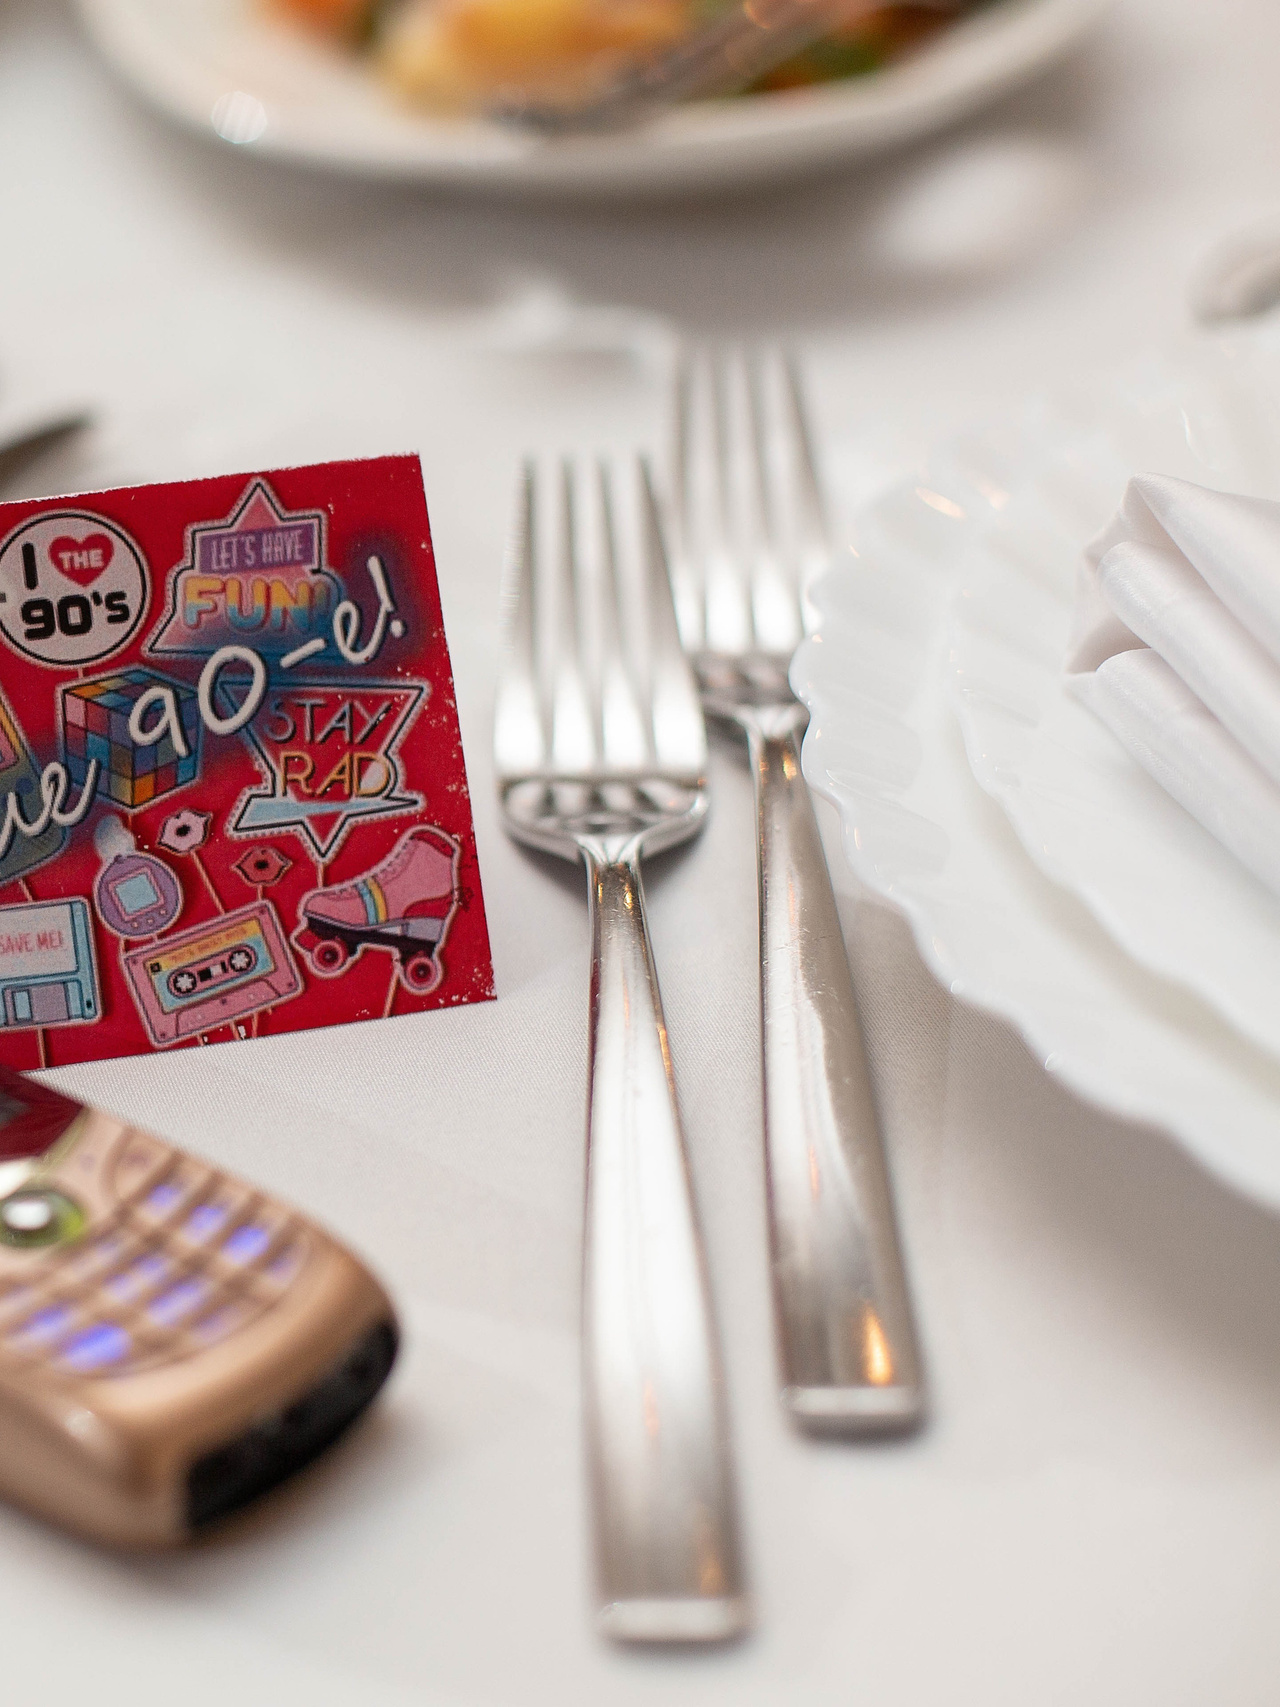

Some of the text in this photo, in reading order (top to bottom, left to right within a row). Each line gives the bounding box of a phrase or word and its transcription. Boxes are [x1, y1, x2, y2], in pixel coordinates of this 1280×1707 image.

[22, 542, 104, 590] I THE
[211, 529, 304, 570] LET'S HAVE
[127, 555, 406, 758] 90-е!
[263, 698, 392, 745] STAY
[280, 751, 391, 797] RAD
[37, 928, 65, 951] ME!
